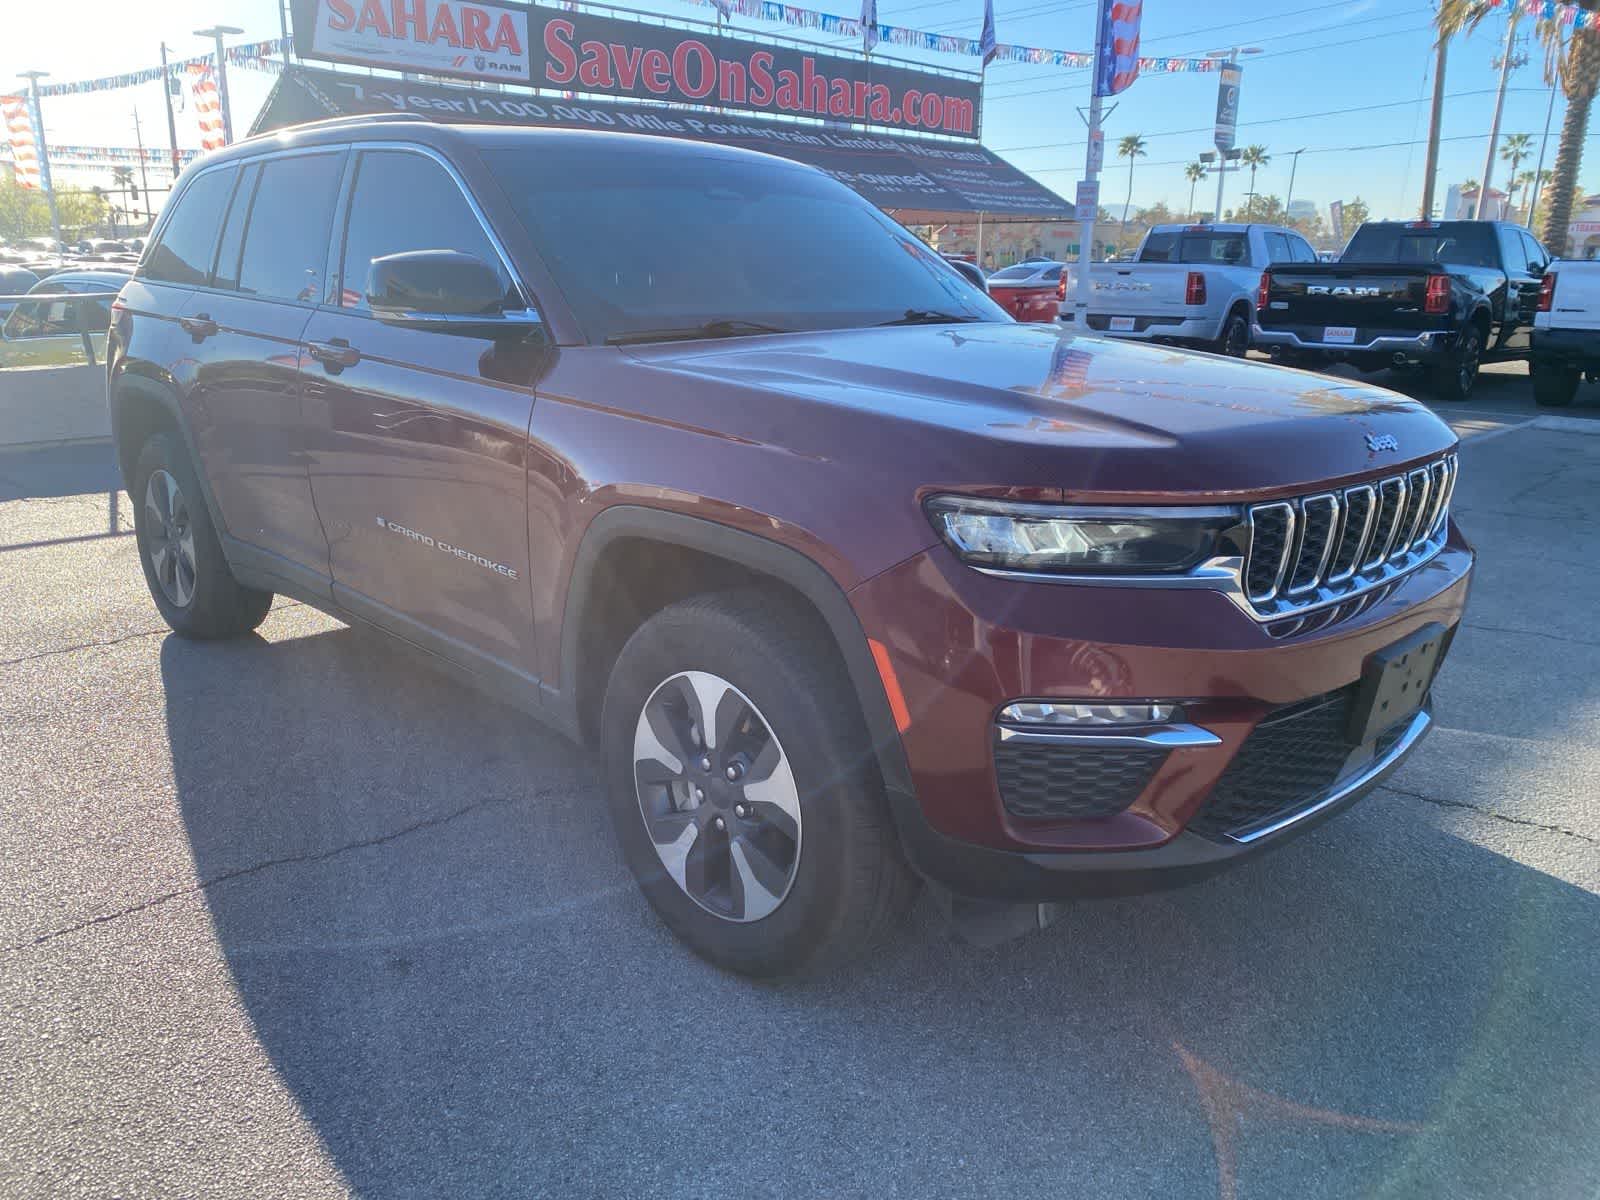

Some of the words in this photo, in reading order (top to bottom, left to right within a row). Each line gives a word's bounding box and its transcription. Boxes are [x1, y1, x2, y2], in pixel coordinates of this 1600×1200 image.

[328, 0, 522, 56] SAHARA
[487, 62, 521, 73] RAM
[543, 18, 974, 134] SaveOnSahara.com
[616, 112, 686, 132] Mile
[684, 118, 828, 147] Powertrain
[821, 133, 904, 152] Limited
[1094, 281, 1152, 292] RAM
[1307, 285, 1380, 297] RAM
[1364, 433, 1398, 452] Jeep
[387, 521, 435, 548] GRAND
[437, 541, 518, 580] CHEROKEE
